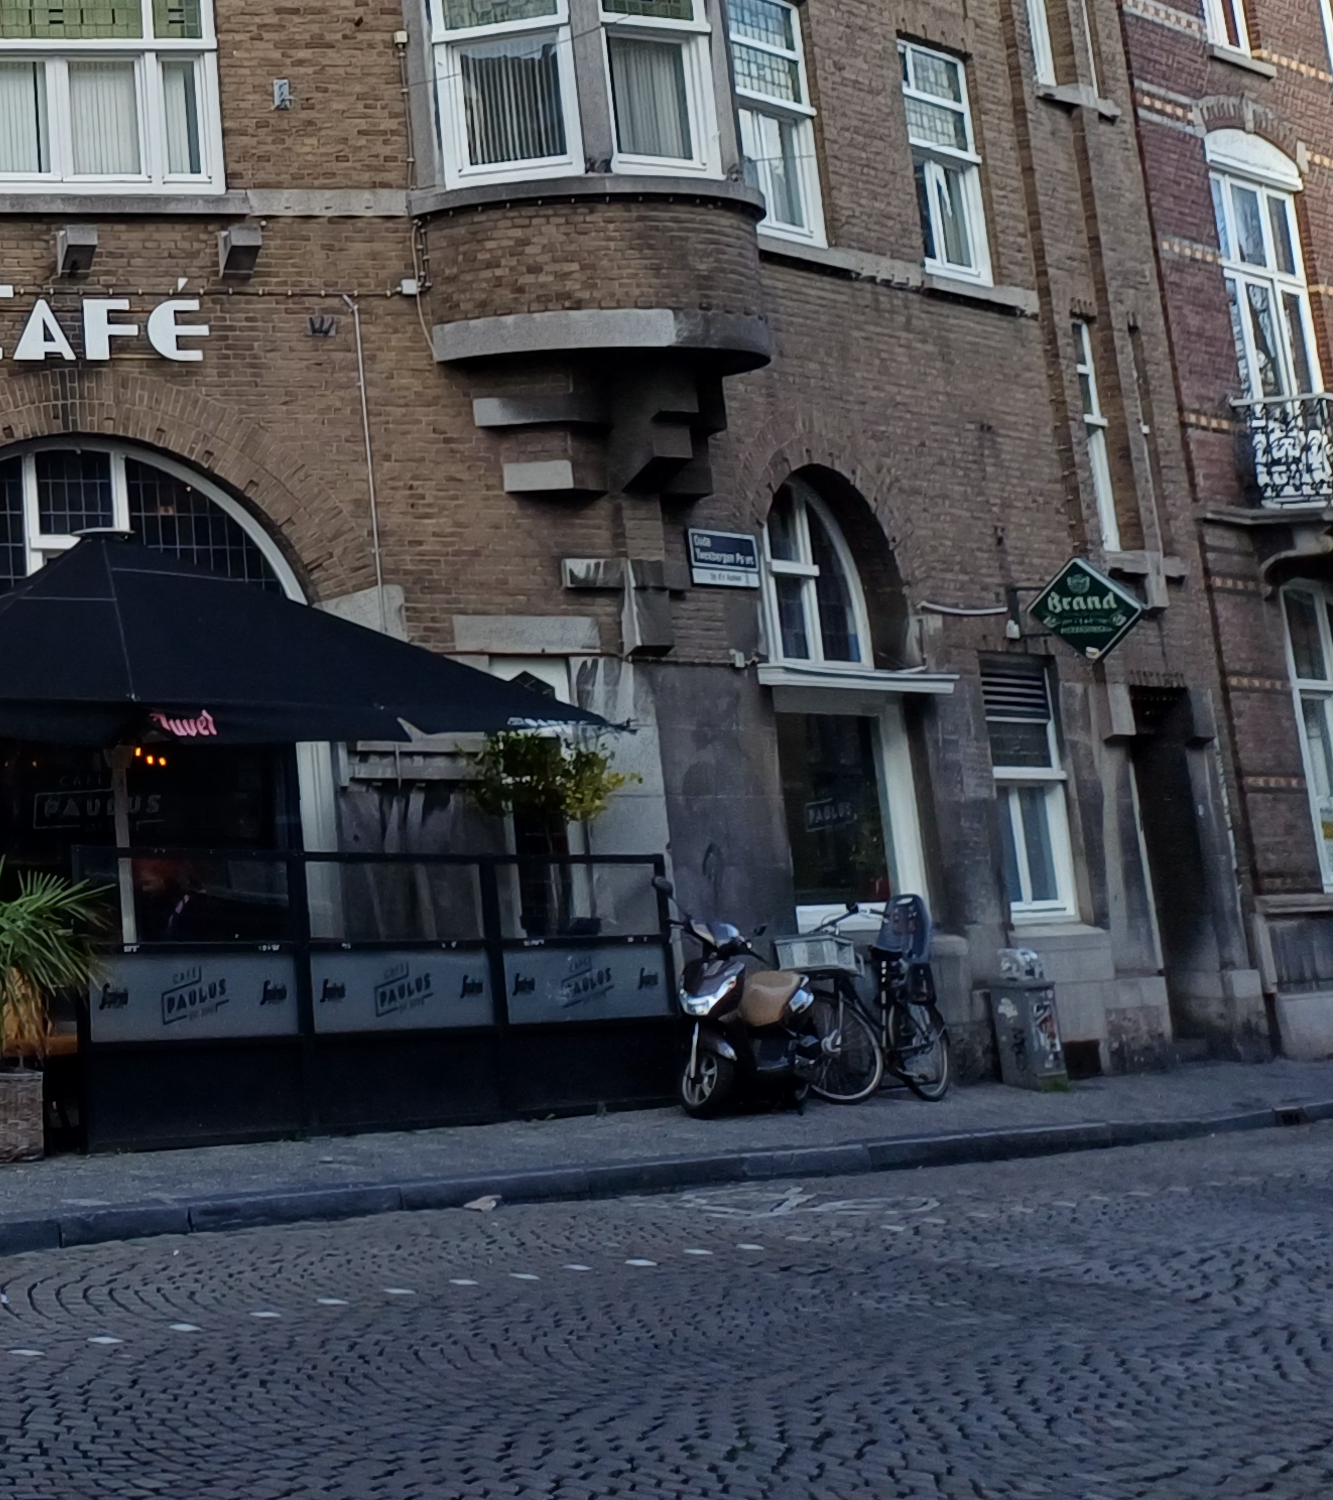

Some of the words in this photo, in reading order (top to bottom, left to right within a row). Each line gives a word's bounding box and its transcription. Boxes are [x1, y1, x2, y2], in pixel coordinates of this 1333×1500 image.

[1047, 591, 1117, 613] Brand
[167, 978, 227, 1014] PAULUS
[379, 972, 432, 1008] PAULUS
[566, 967, 612, 997] AULUS
